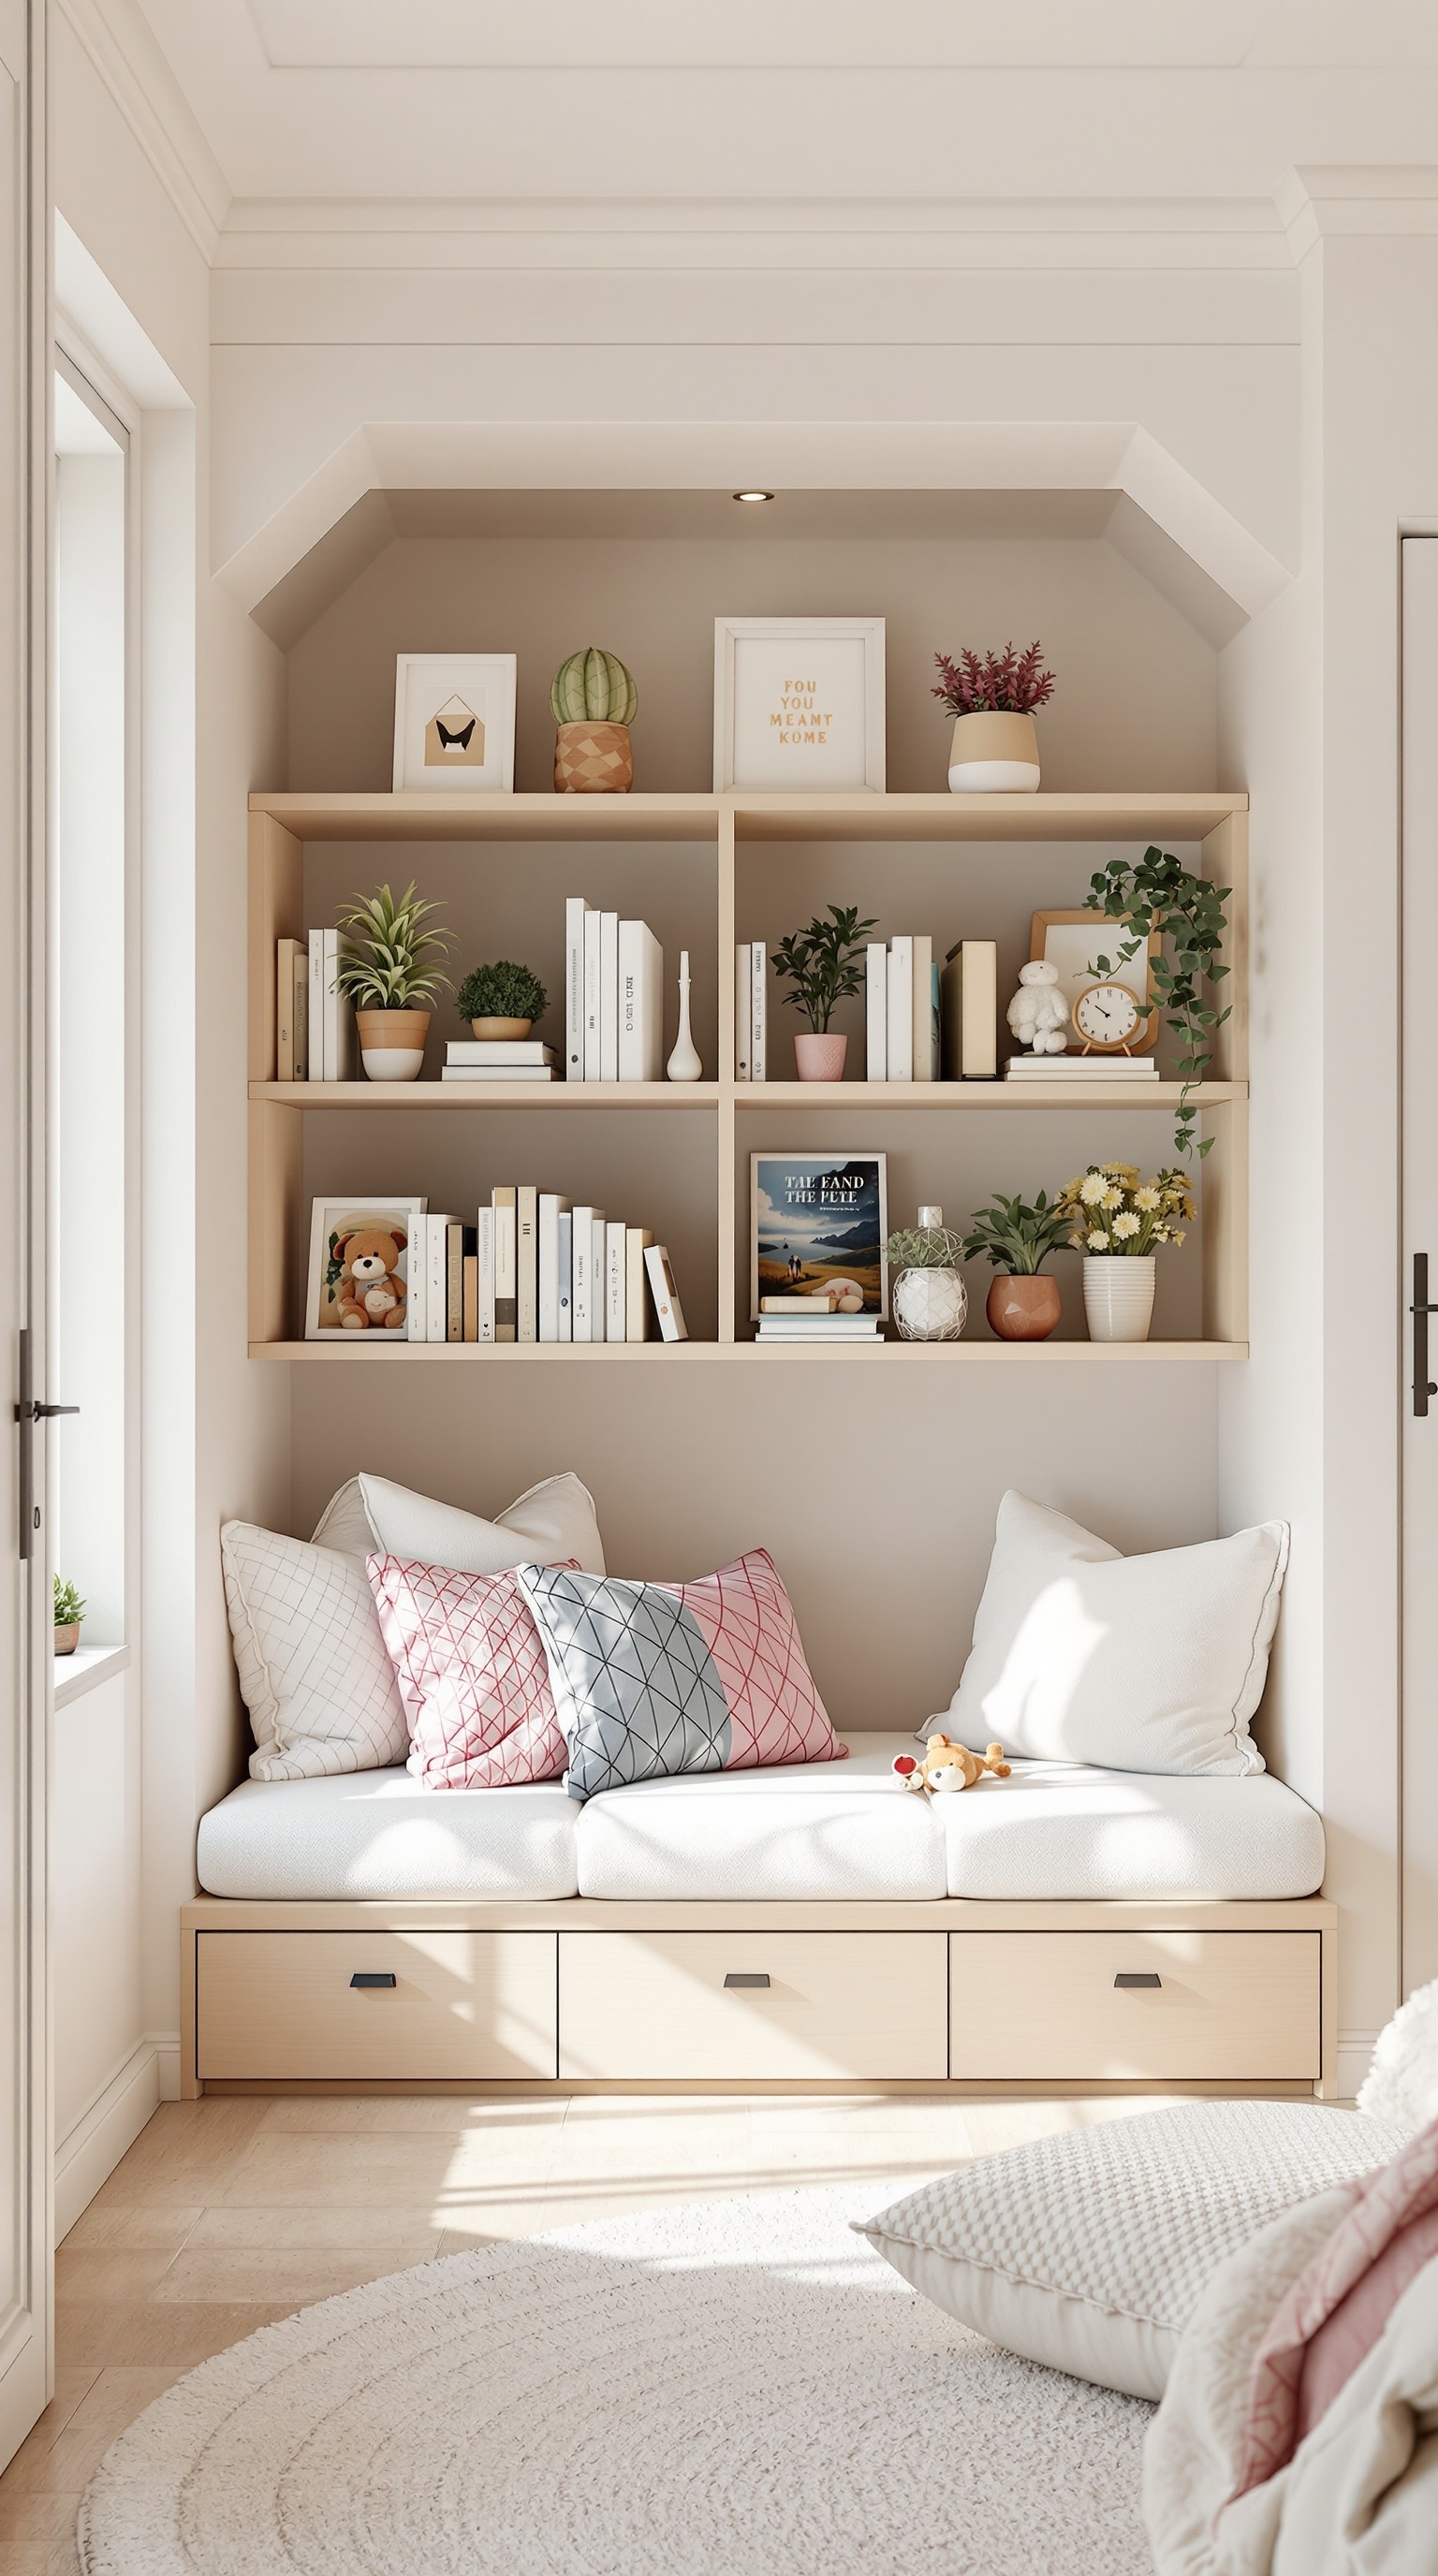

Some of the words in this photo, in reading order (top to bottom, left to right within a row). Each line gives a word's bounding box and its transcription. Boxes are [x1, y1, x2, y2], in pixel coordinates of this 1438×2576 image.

[784, 680, 816, 693] FOU
[780, 696, 814, 710] YOU
[770, 713, 833, 726] MEANT
[779, 731, 827, 744] KOME
